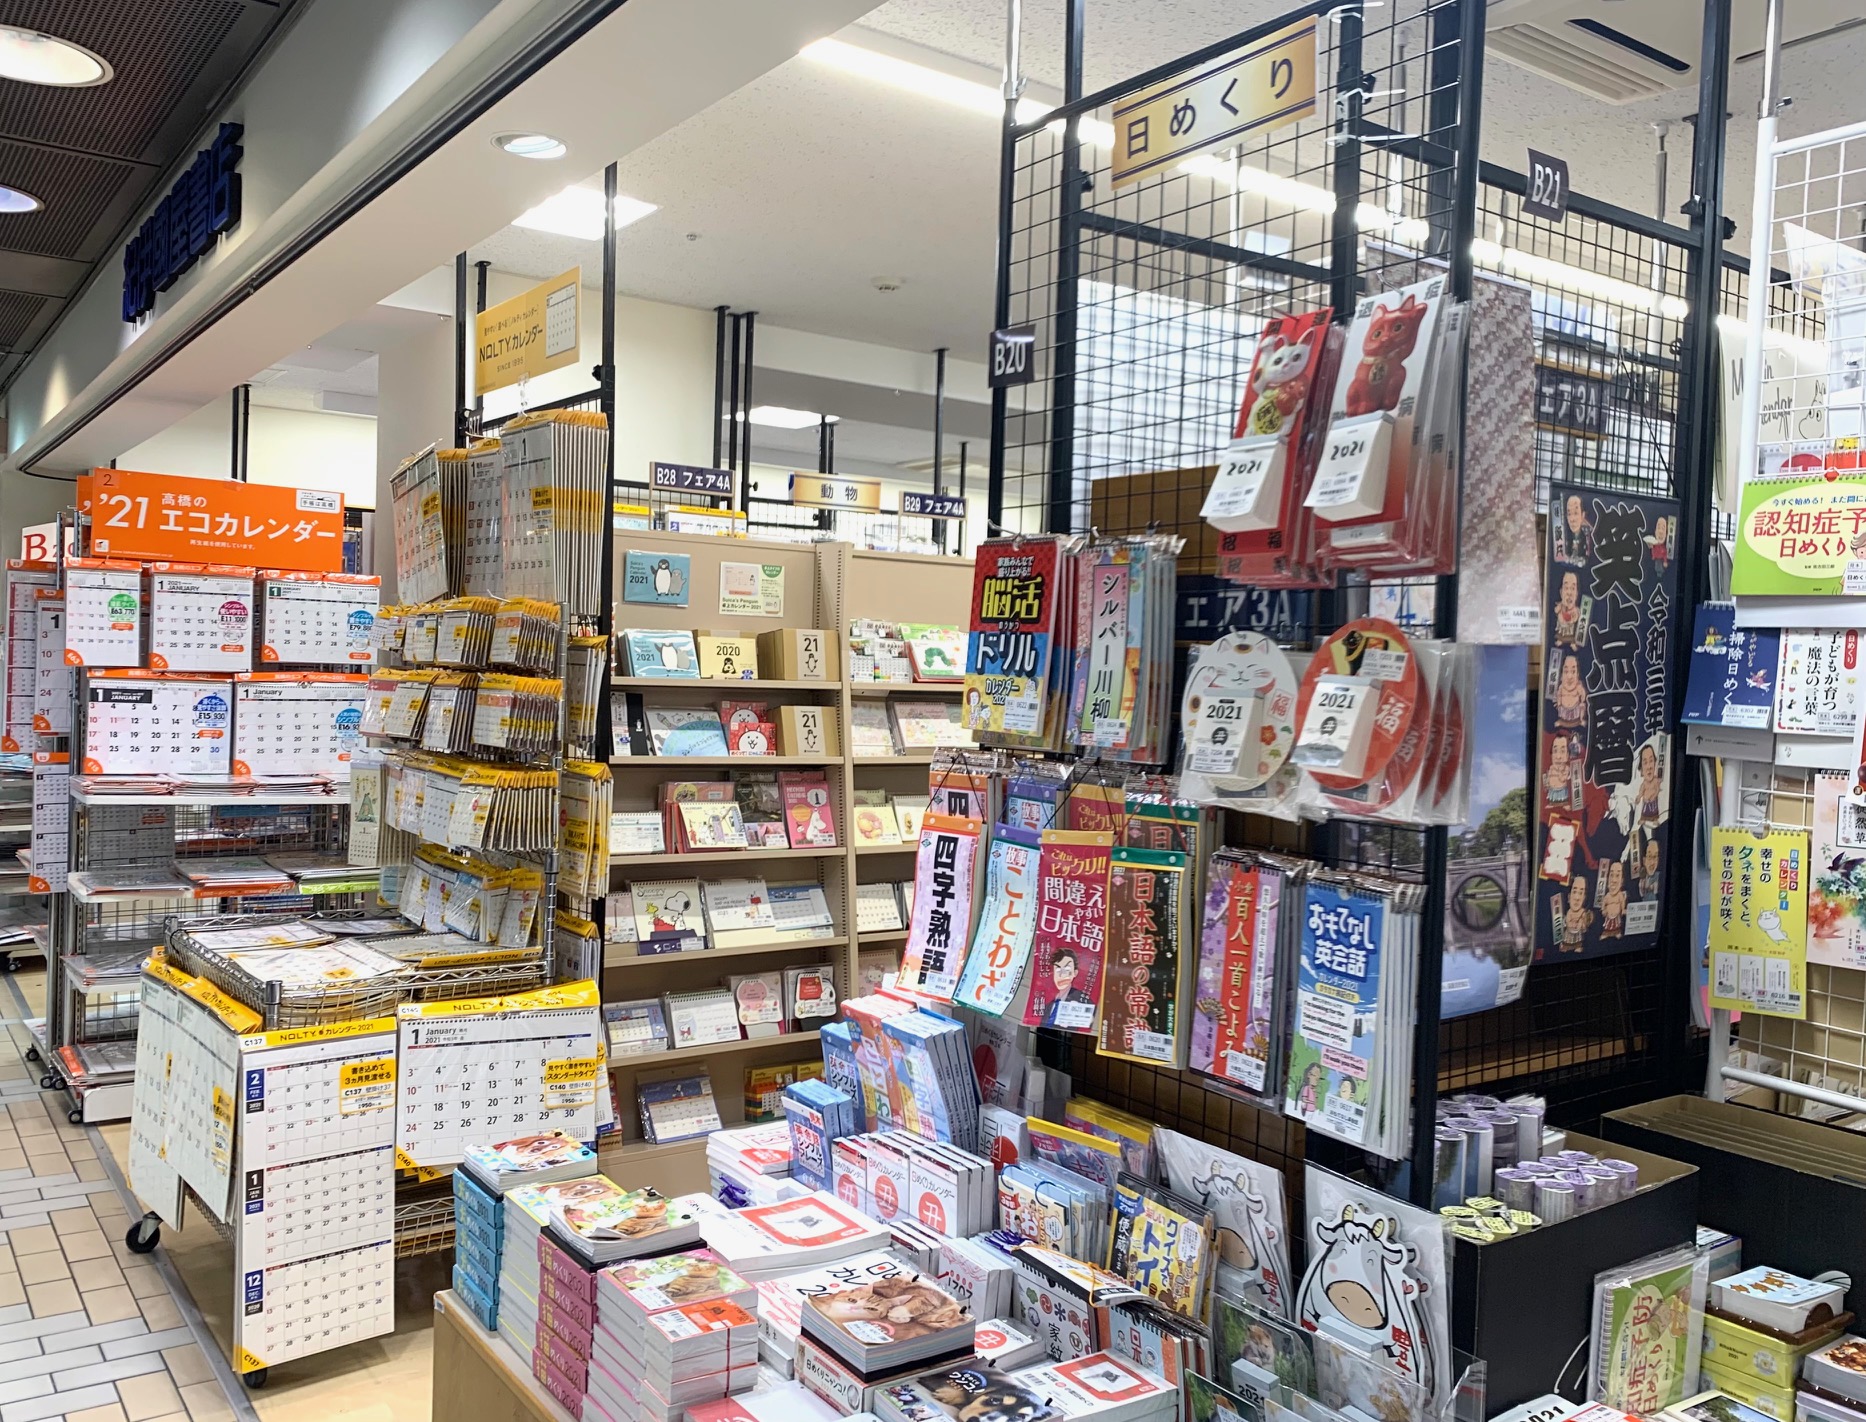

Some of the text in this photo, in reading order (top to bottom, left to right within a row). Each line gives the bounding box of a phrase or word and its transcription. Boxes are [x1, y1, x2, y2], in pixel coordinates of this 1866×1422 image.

[1127, 57, 1293, 160] 日めくり
[1533, 162, 1561, 210] B21
[994, 341, 1026, 377] B20
[1330, 440, 1365, 461] 2021
[1227, 460, 1262, 476] 2021
[103, 474, 113, 487] 2
[657, 467, 730, 491] B28 フェア4A
[161, 493, 207, 508] 高橋の
[821, 483, 858, 501] 動物
[904, 496, 964, 517] B29 フェア4A
[160, 510, 336, 543] エコカレンダー
[1753, 507, 1866, 538] 認知症予
[1779, 536, 1846, 558] 日めくり
[157, 580, 164, 590] 1
[629, 575, 649, 585] 2021
[271, 587, 278, 596] 1
[982, 576, 1043, 620] 脳活
[220, 615, 232, 623] E11
[716, 645, 741, 657] 2020
[804, 638, 819, 652] 21
[976, 633, 1036, 672] ドリル
[1091, 573, 1120, 721] シルバー川柳
[1583, 498, 1647, 789] 笑点暦
[1846, 636, 1855, 665] 日めくり
[636, 653, 655, 662] 2021
[1645, 583, 1669, 736] 令和三年
[1822, 630, 1842, 712] 子どもが育つ
[985, 679, 1020, 695] カレンダー
[1804, 646, 1822, 716] 魔法の言葉
[96, 689, 104, 702] 1
[243, 688, 283, 699] 1 January
[1318, 692, 1355, 709] 2021
[1206, 704, 1243, 720] 2021
[1270, 693, 1291, 717] 福
[802, 713, 818, 729] 21
[1376, 696, 1404, 736] 福
[1021, 803, 1040, 822] 故事
[1005, 846, 1028, 868] 故事
[1051, 849, 1073, 862] これは
[1759, 848, 1773, 883] 幸せの
[1789, 849, 1799, 891] 日めくり
[1044, 876, 1107, 909] 間違え
[1720, 845, 1734, 932] 幸せの花が咲く
[1779, 859, 1789, 910] カレンダー
[917, 834, 960, 986] 四字熟語
[1074, 907, 1103, 919] やすい
[974, 866, 1024, 1001] ことわざ
[1040, 905, 1105, 952] 日本語
[1308, 903, 1376, 950] おもてなし
[1314, 938, 1368, 978] 英会話
[1219, 895, 1253, 1059] 百人一首こよみ
[244, 1038, 263, 1046] C137
[280, 1023, 374, 1042] NOLTY カレンダー 2021
[411, 1026, 457, 1045] 1 January
[351, 1063, 386, 1075] 書き込めて
[547, 1069, 596, 1080] スタンダードタイプ
[548, 1062, 595, 1072] 見やすく書きやすい
[250, 1073, 260, 1085] 2
[406, 1077, 524, 1096] 10 11 12 13 14
[344, 1088, 362, 1096] C137
[405, 1108, 575, 1132] 24 25 26 27 28 29 30
[794, 1123, 821, 1148] 英会話
[397, 1153, 411, 1167] C140
[250, 1173, 258, 1186] 1
[419, 1166, 435, 1178] C140
[246, 1274, 261, 1287] 12
[243, 1354, 260, 1367] C137
